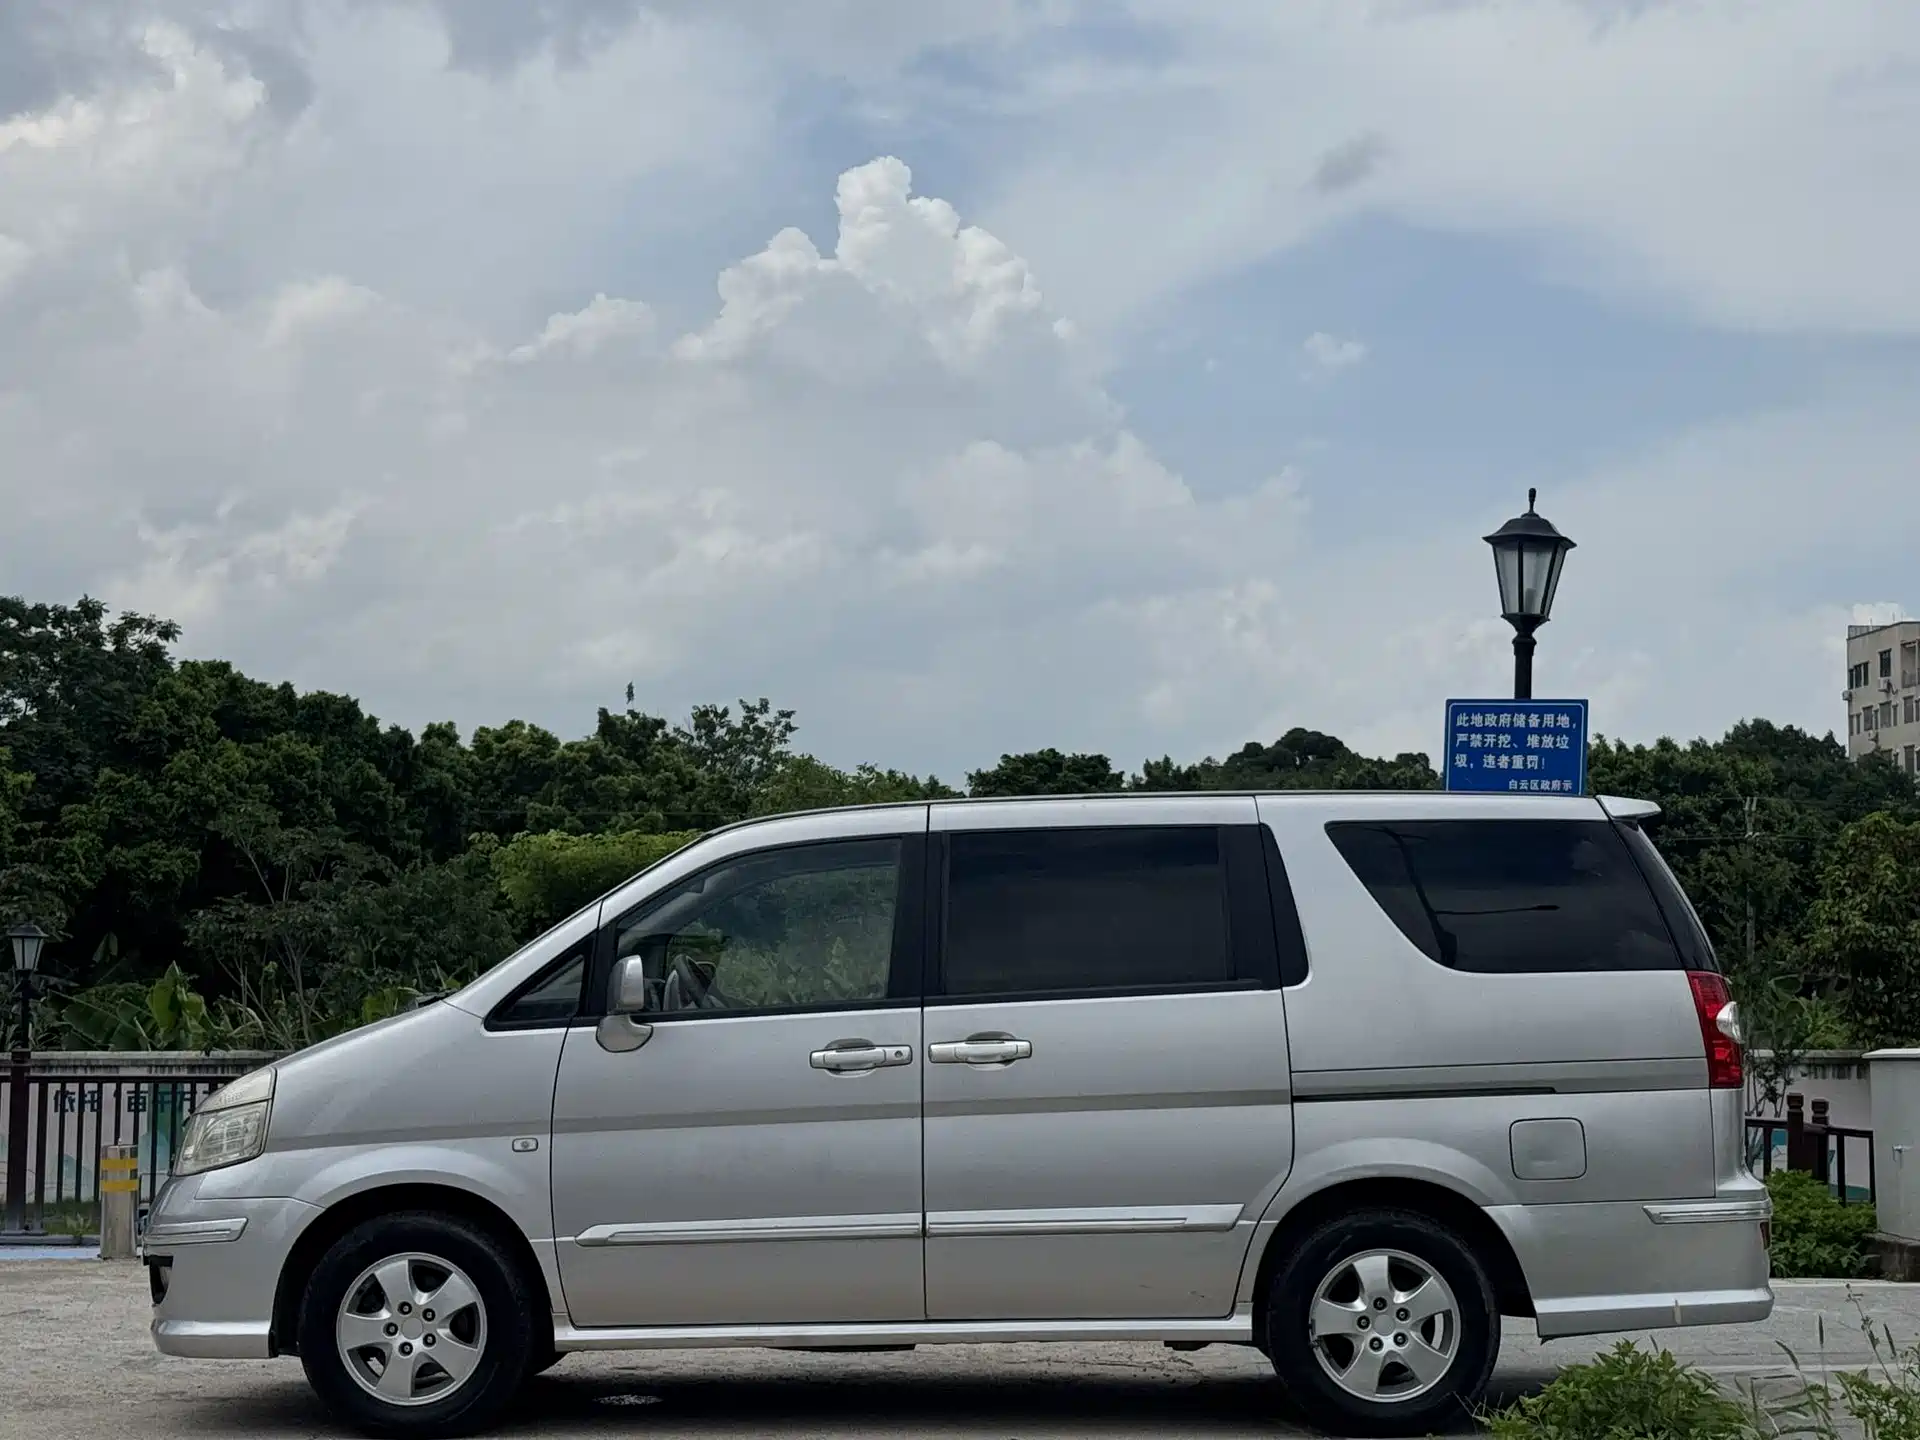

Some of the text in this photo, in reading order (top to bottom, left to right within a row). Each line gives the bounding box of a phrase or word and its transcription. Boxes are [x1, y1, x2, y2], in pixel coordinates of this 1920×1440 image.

[1455, 733, 1569, 749] 严禁开挖、堆放垃
[1508, 778, 1573, 791] 白云区政府示
